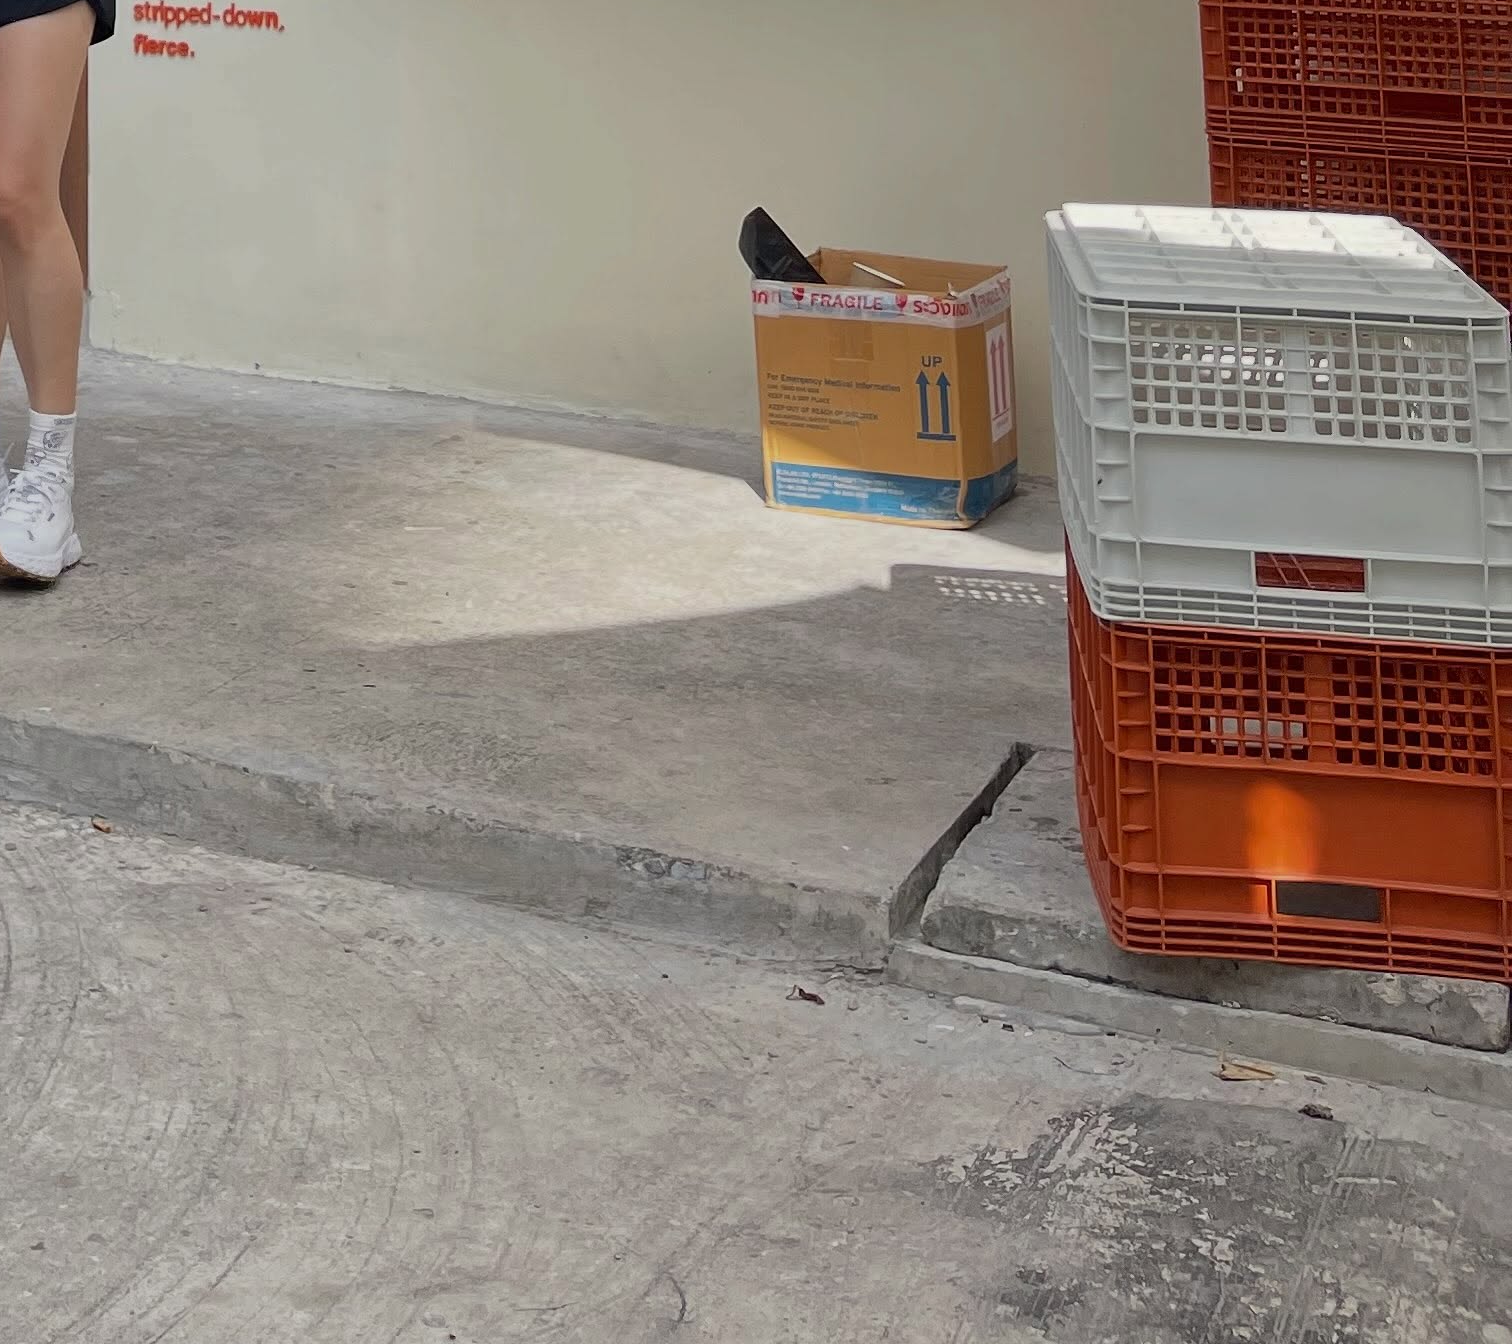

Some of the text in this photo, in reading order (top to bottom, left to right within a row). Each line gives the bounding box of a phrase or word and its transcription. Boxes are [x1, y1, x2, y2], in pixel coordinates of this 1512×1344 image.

[133, 0, 286, 31] stripped-down,
[133, 34, 196, 59] fierce.
[810, 292, 883, 310] FRAGILE
[921, 355, 942, 368] UP
